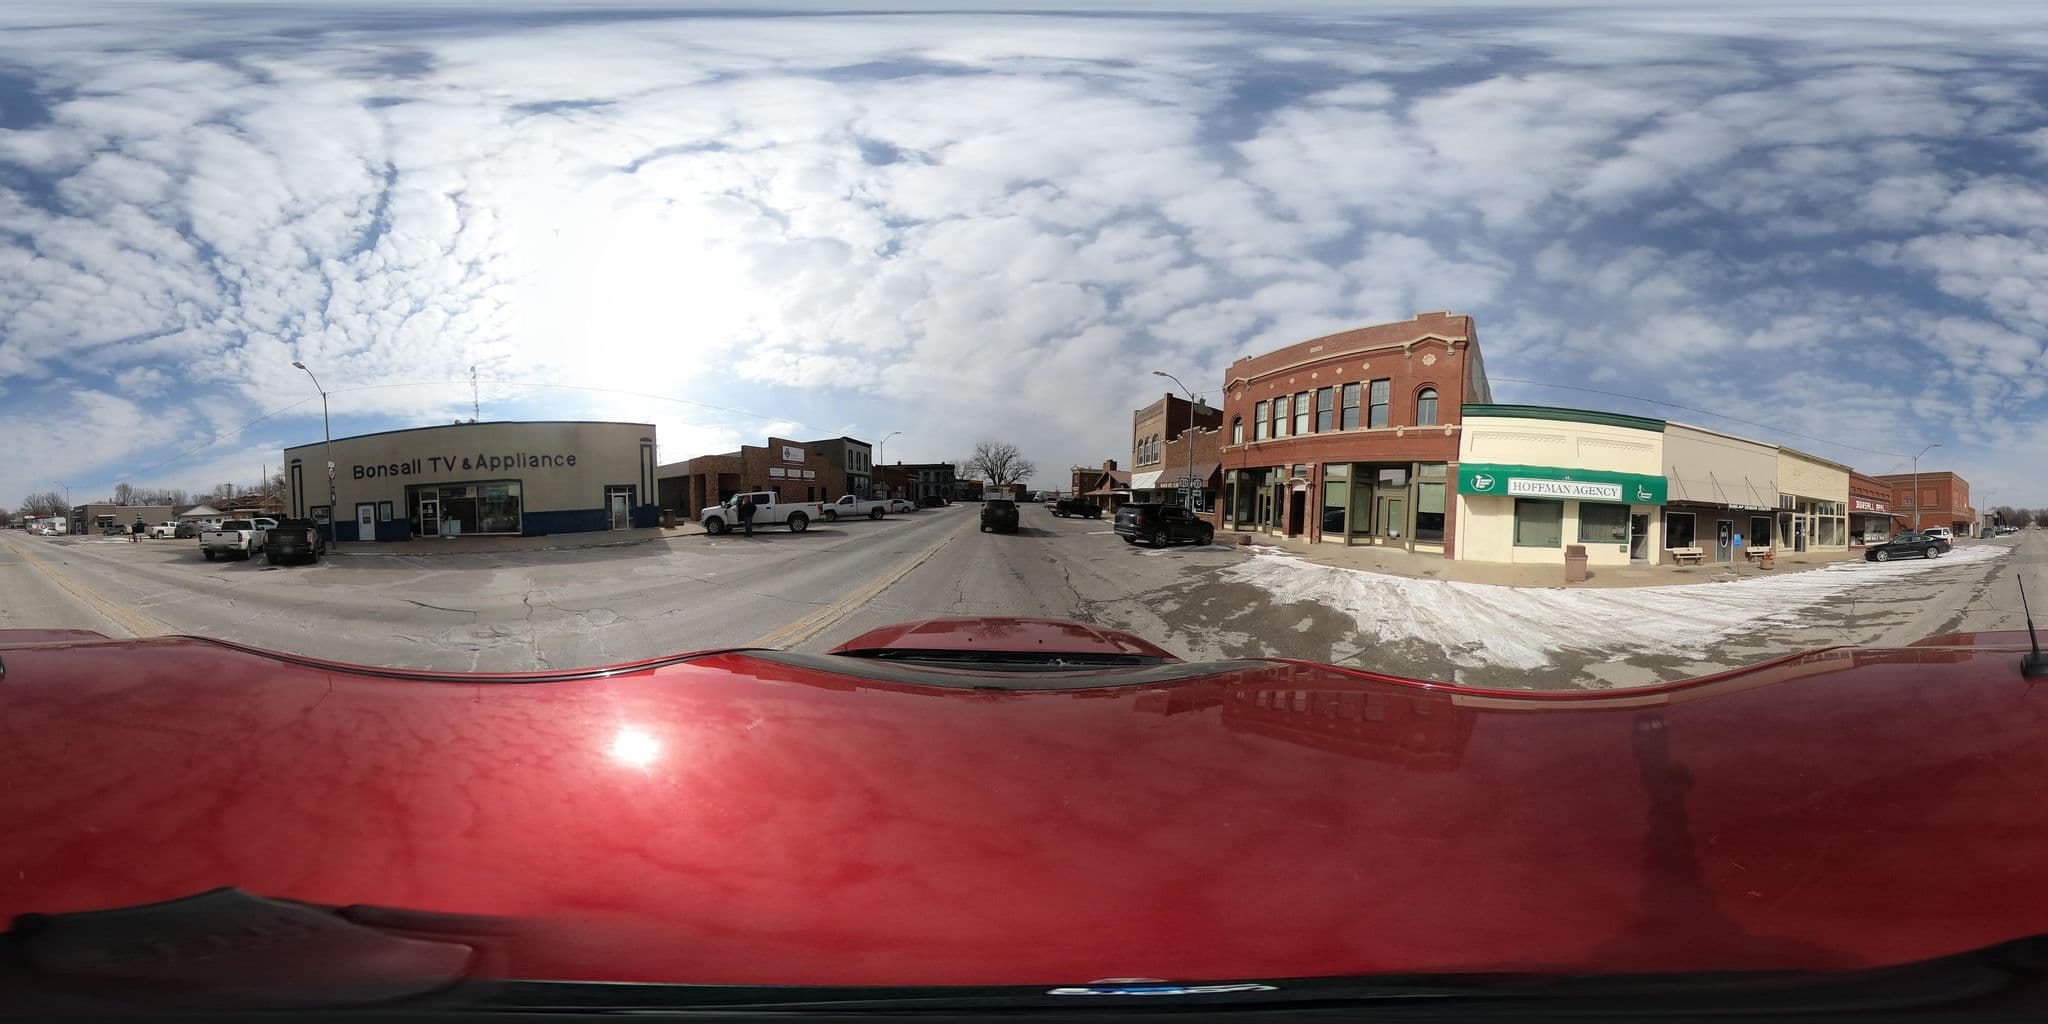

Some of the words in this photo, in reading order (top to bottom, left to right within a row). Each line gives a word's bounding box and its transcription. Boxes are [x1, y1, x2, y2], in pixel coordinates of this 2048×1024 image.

[353, 459, 421, 480] Bonsall
[428, 456, 457, 472] TV
[462, 457, 472, 470] &
[475, 453, 576, 471] Appliance
[1513, 481, 1571, 494] HOFFMAN
[1573, 485, 1618, 497] AGENCY
